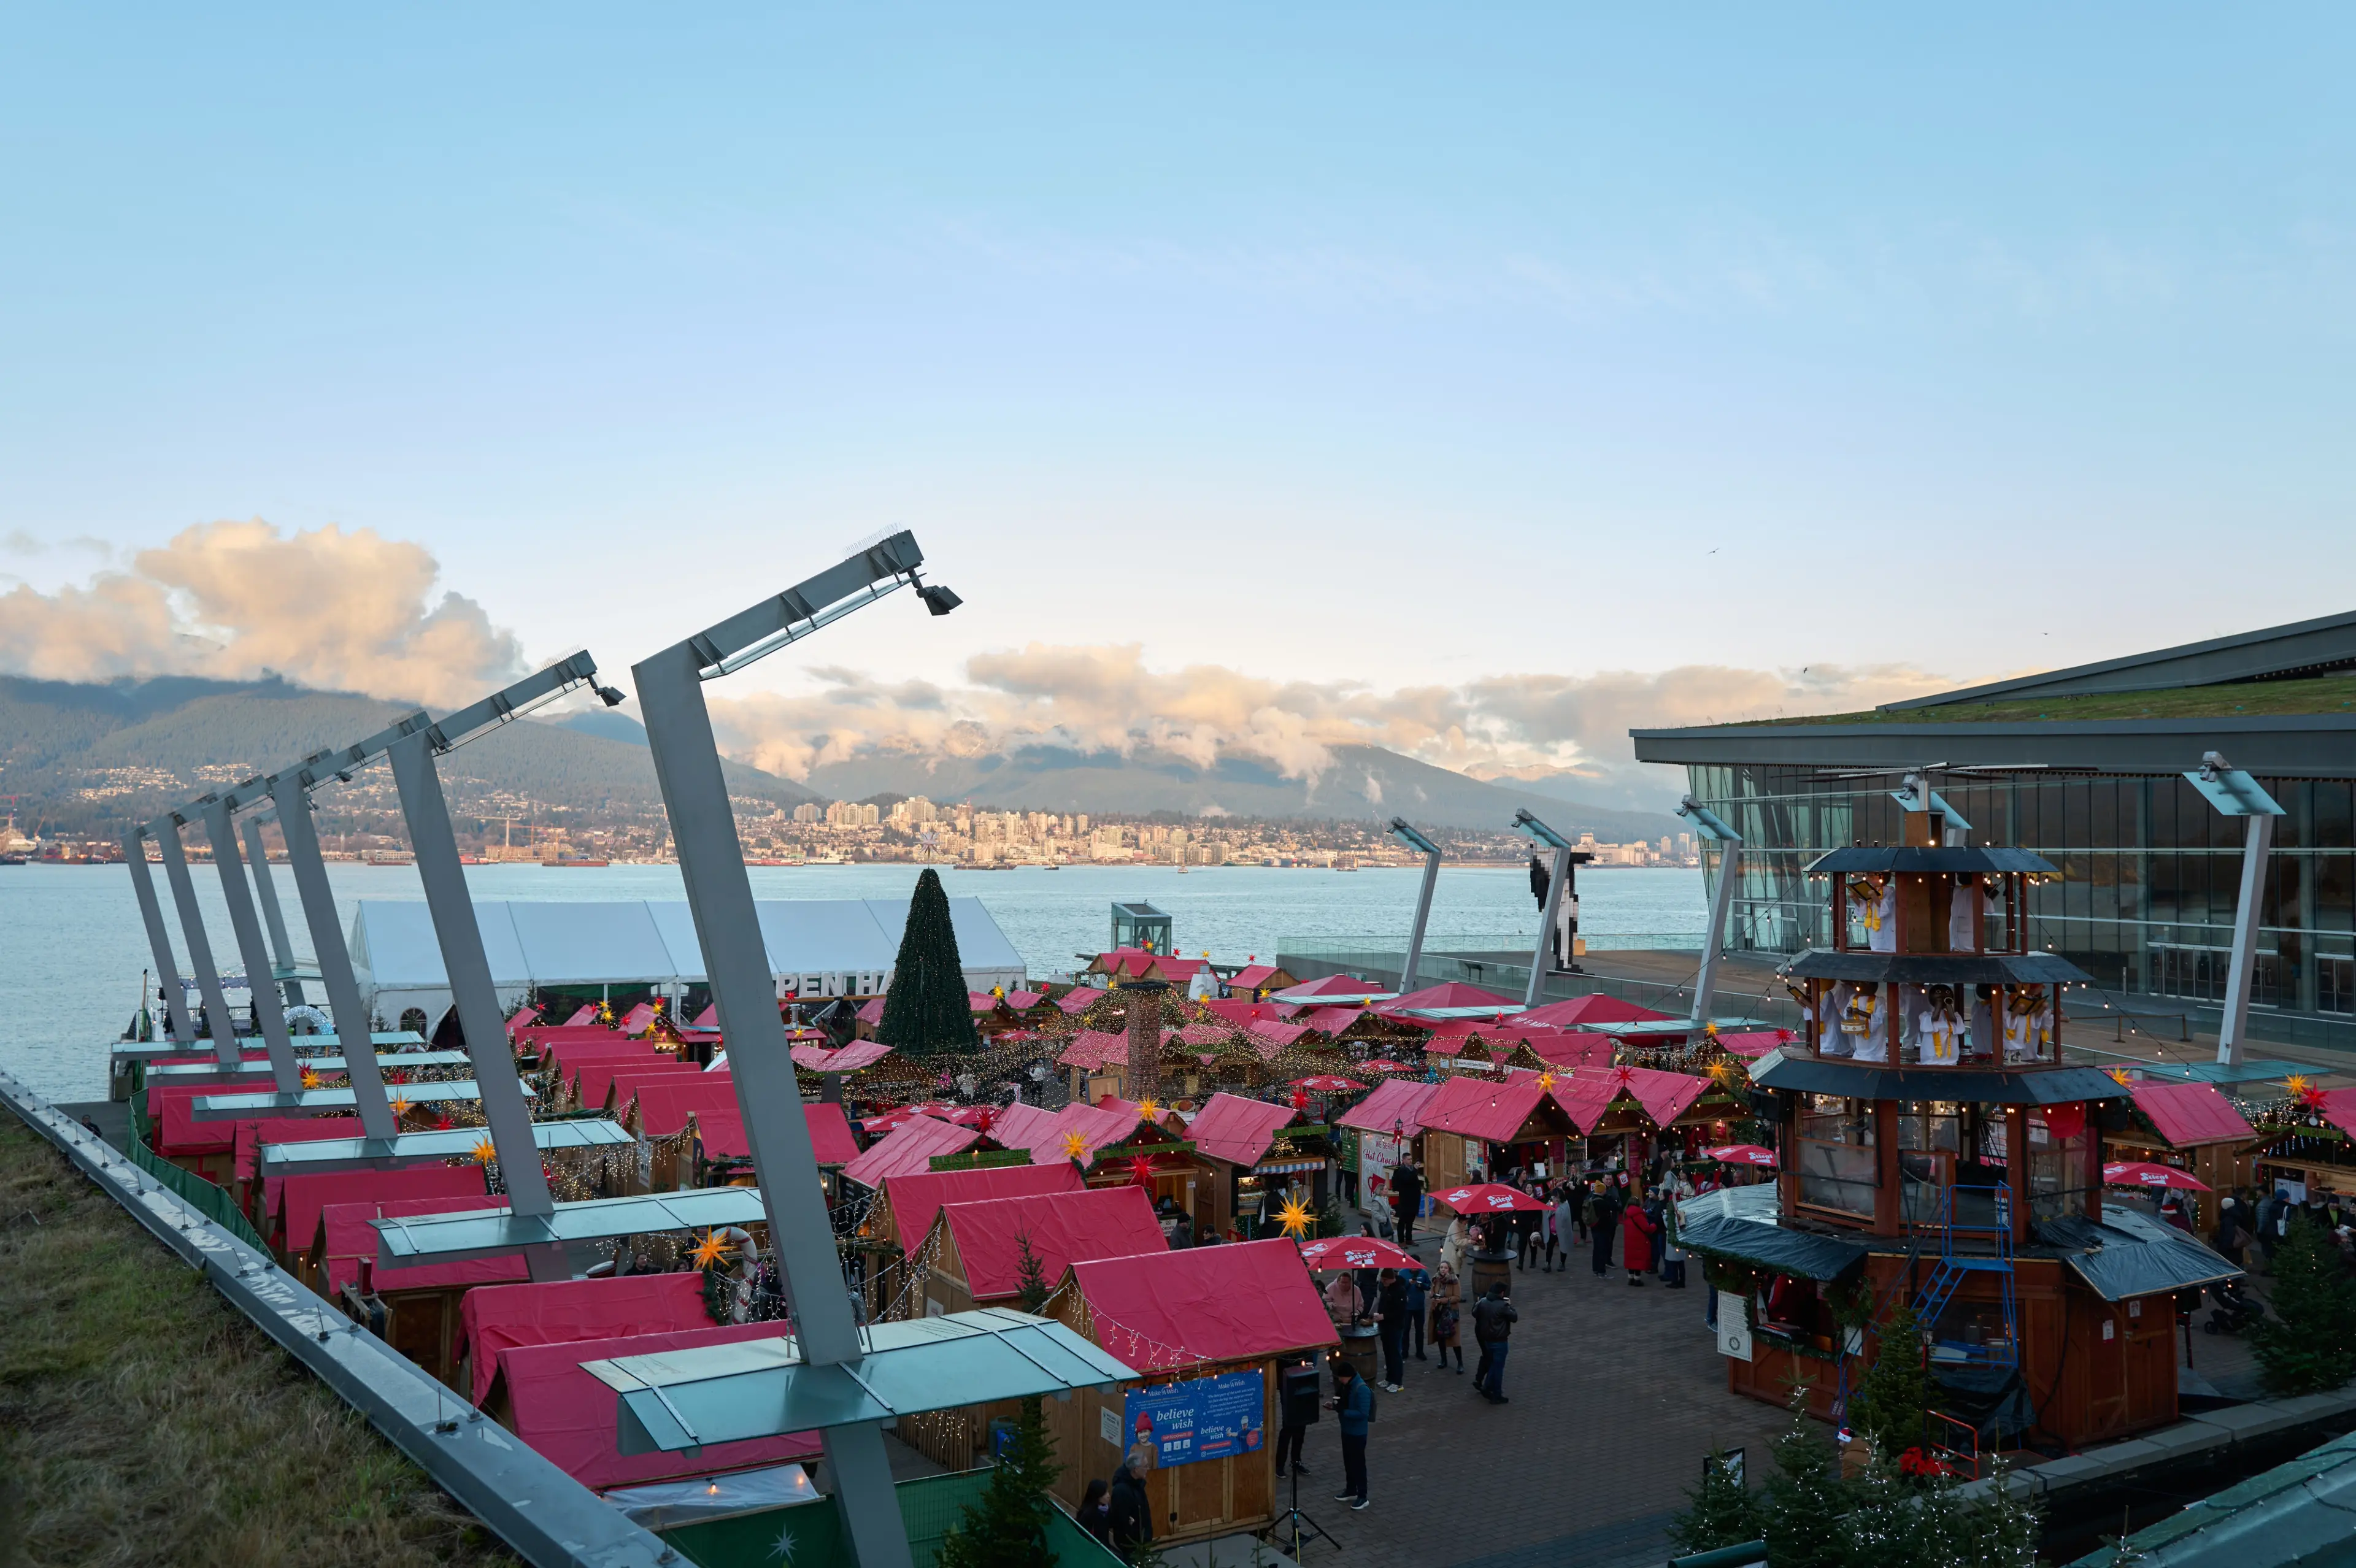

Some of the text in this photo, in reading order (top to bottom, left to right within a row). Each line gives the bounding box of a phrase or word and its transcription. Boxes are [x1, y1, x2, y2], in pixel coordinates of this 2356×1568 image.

[776, 972, 844, 998] PEN
[1383, 1142, 1395, 1151] SERVE
[1363, 1148, 1399, 1165] Hot Chocol
[1487, 1194, 1514, 1206] Stiegl
[1345, 1250, 1377, 1262] Stiegl
[1157, 1409, 1194, 1421] believe
[1172, 1418, 1193, 1429] wish
[1201, 1426, 1224, 1435] believe
